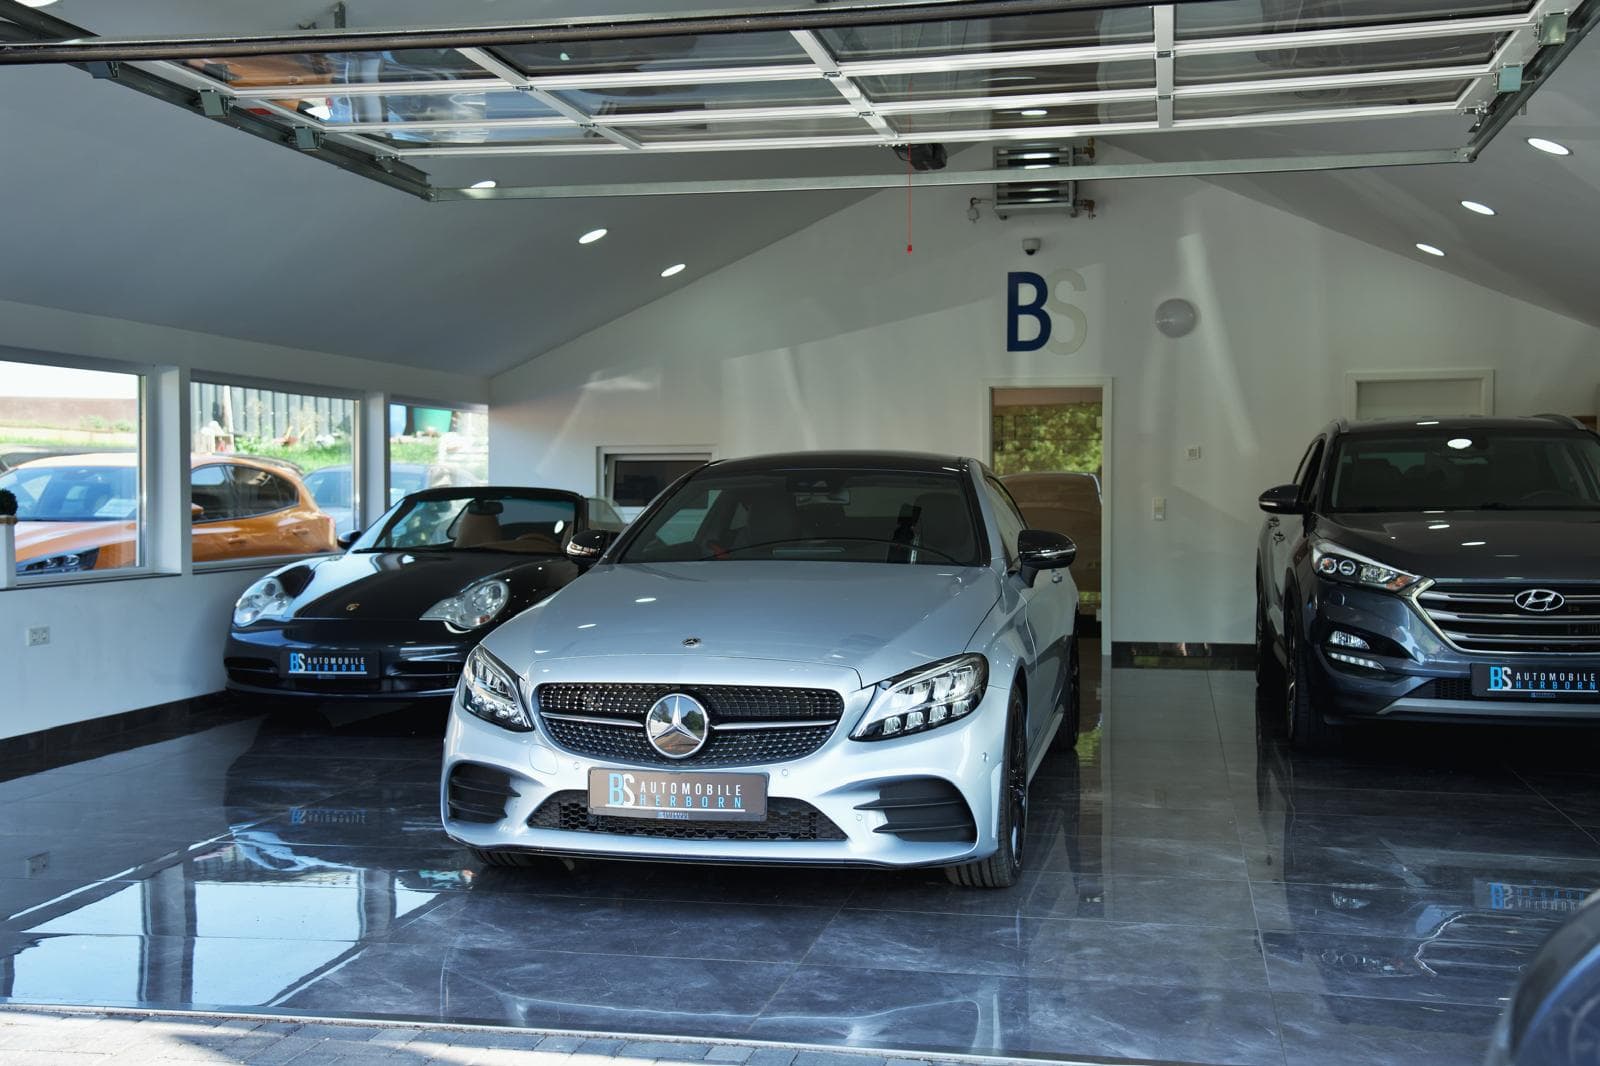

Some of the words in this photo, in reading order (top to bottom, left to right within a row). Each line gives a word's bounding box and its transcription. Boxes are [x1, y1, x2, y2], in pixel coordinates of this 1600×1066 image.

[1007, 268, 1088, 356] BS
[289, 652, 306, 672] BS
[307, 657, 365, 665] AUTOMOBILE
[1489, 666, 1513, 690] BS
[1515, 672, 1596, 681] AUTOMOBILE
[1515, 680, 1596, 690] HERBORN
[608, 773, 636, 806] BS
[640, 781, 742, 796] AUTOMOBILE
[640, 793, 742, 808] HERBORN
